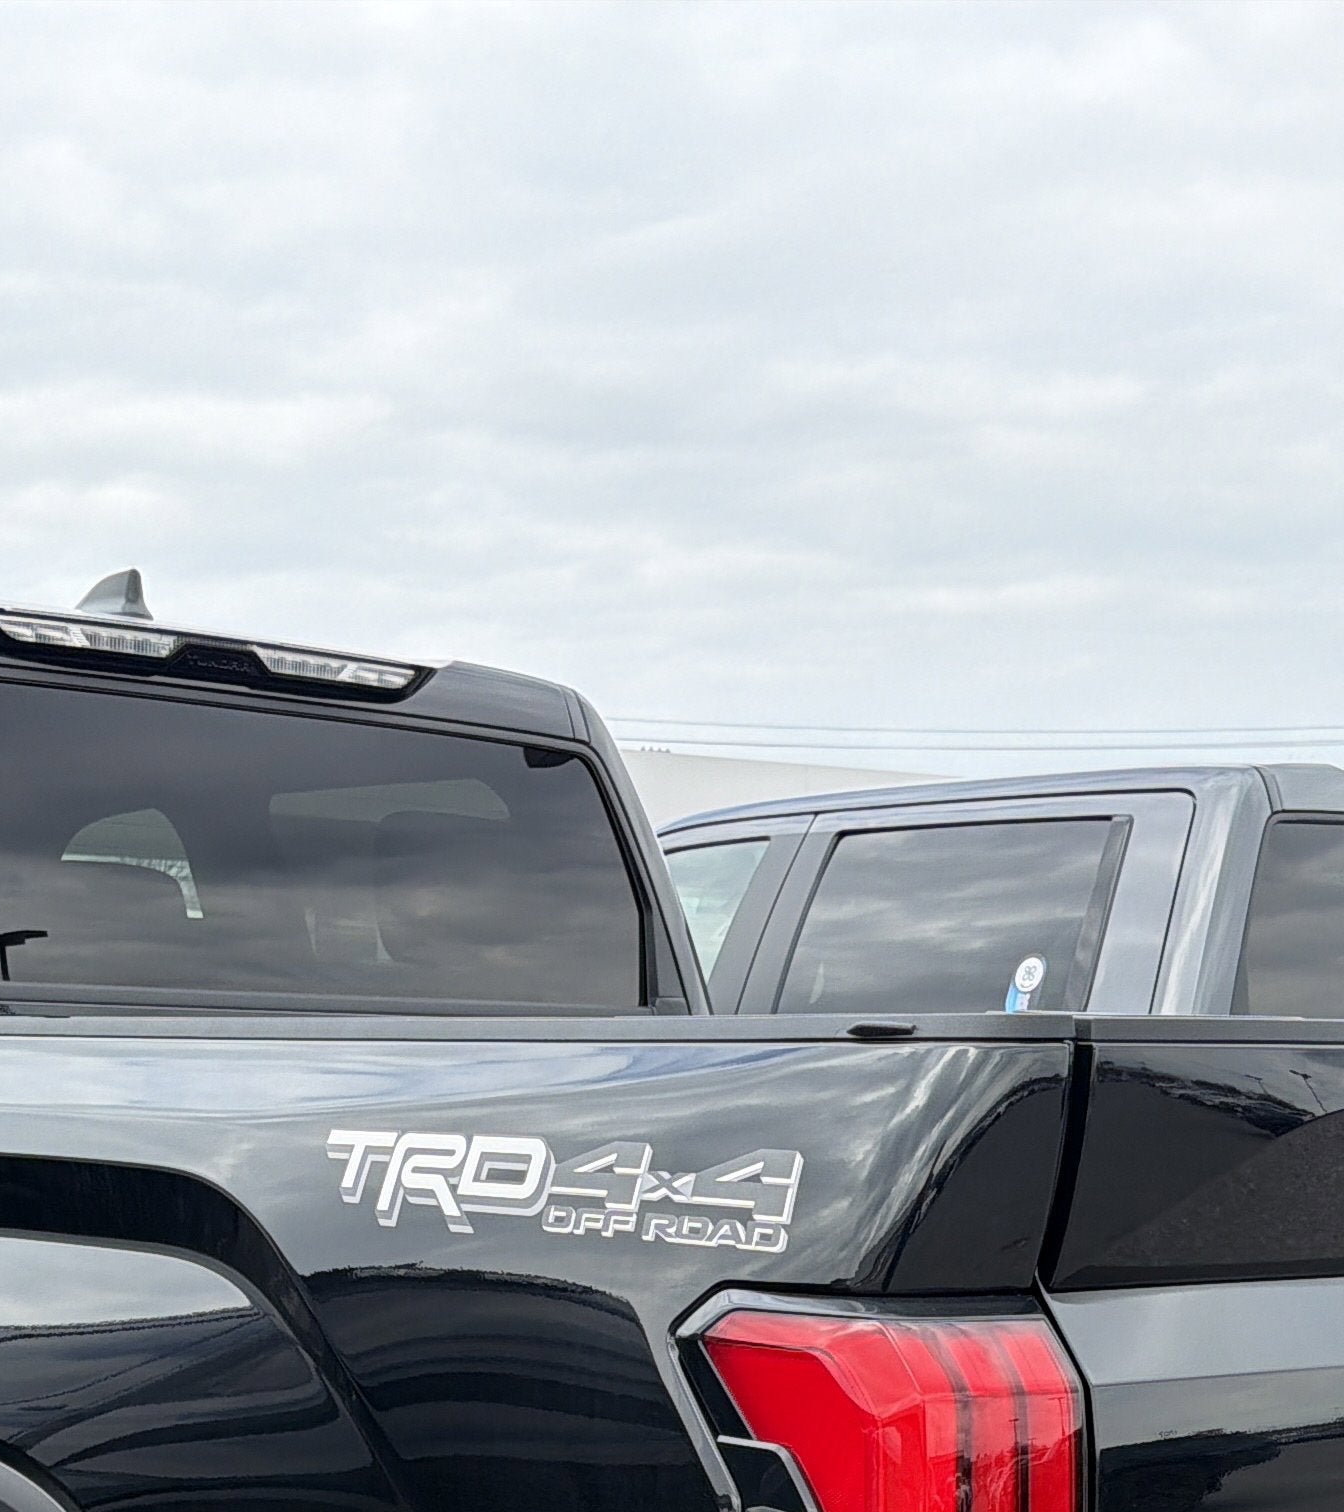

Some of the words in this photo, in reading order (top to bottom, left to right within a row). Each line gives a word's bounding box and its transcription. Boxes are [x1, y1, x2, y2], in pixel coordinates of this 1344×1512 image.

[326, 1128, 554, 1235] TRD
[551, 1140, 805, 1226] 4x4
[542, 1204, 638, 1238] OFF
[642, 1210, 789, 1254] ROAD
